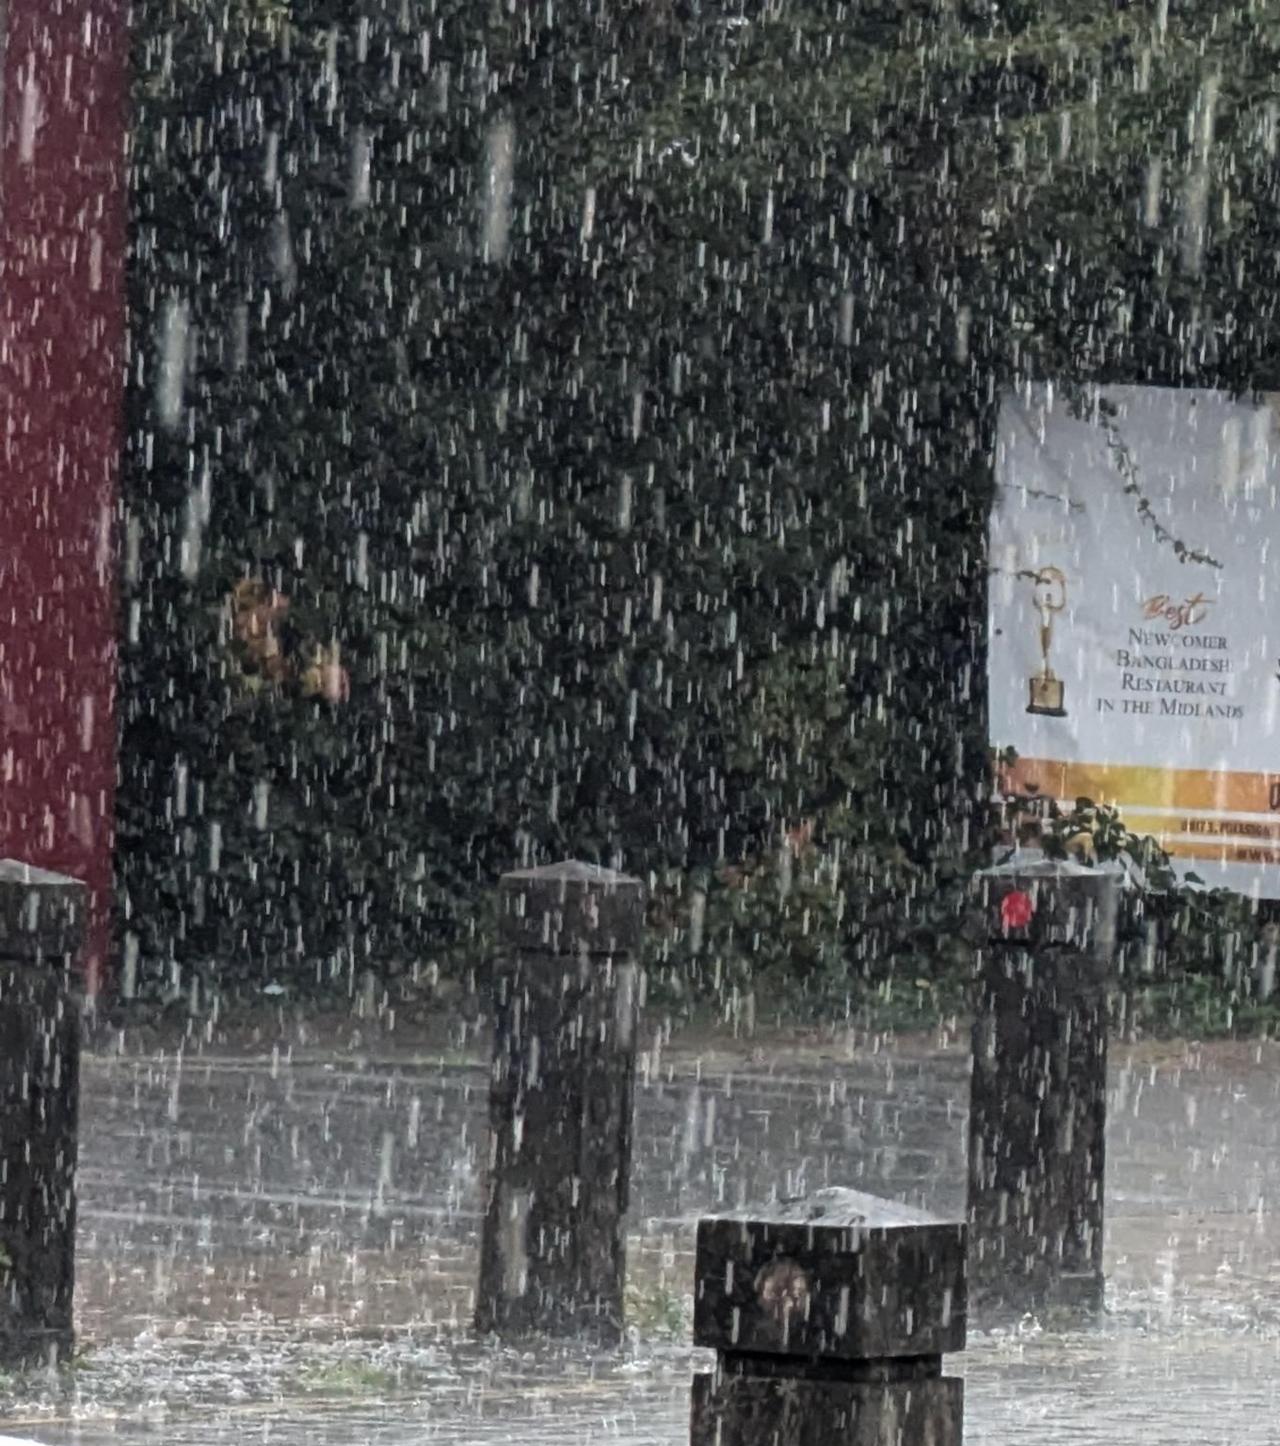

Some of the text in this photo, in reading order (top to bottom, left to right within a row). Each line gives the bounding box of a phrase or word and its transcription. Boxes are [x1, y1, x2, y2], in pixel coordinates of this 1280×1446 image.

[1142, 592, 1216, 631] Best
[1128, 628, 1228, 649] NEWCOMER
[1122, 672, 1228, 696] RESTAURANT
[1096, 698, 1245, 719] IN THE MIDLANDS
